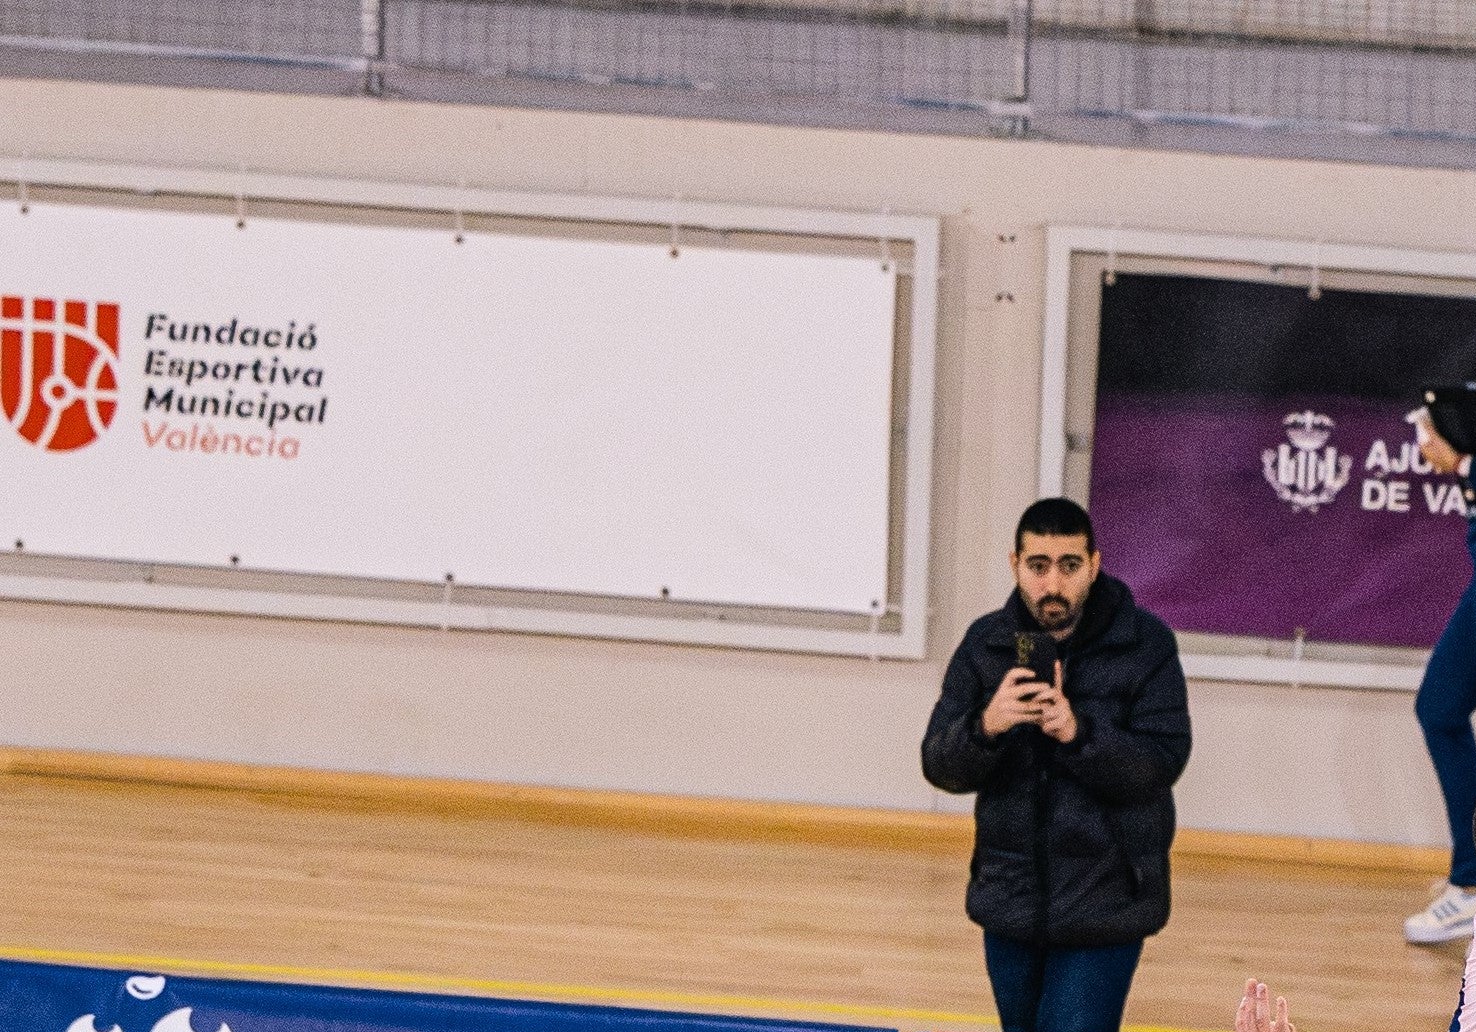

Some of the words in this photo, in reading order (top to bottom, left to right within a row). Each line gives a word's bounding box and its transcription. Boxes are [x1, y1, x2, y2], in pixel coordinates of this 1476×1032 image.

[145, 313, 318, 350] Fundació
[145, 349, 324, 388] Esportiva
[144, 386, 328, 429] Municipal
[142, 419, 301, 460] València
[1361, 479, 1411, 512] DE
